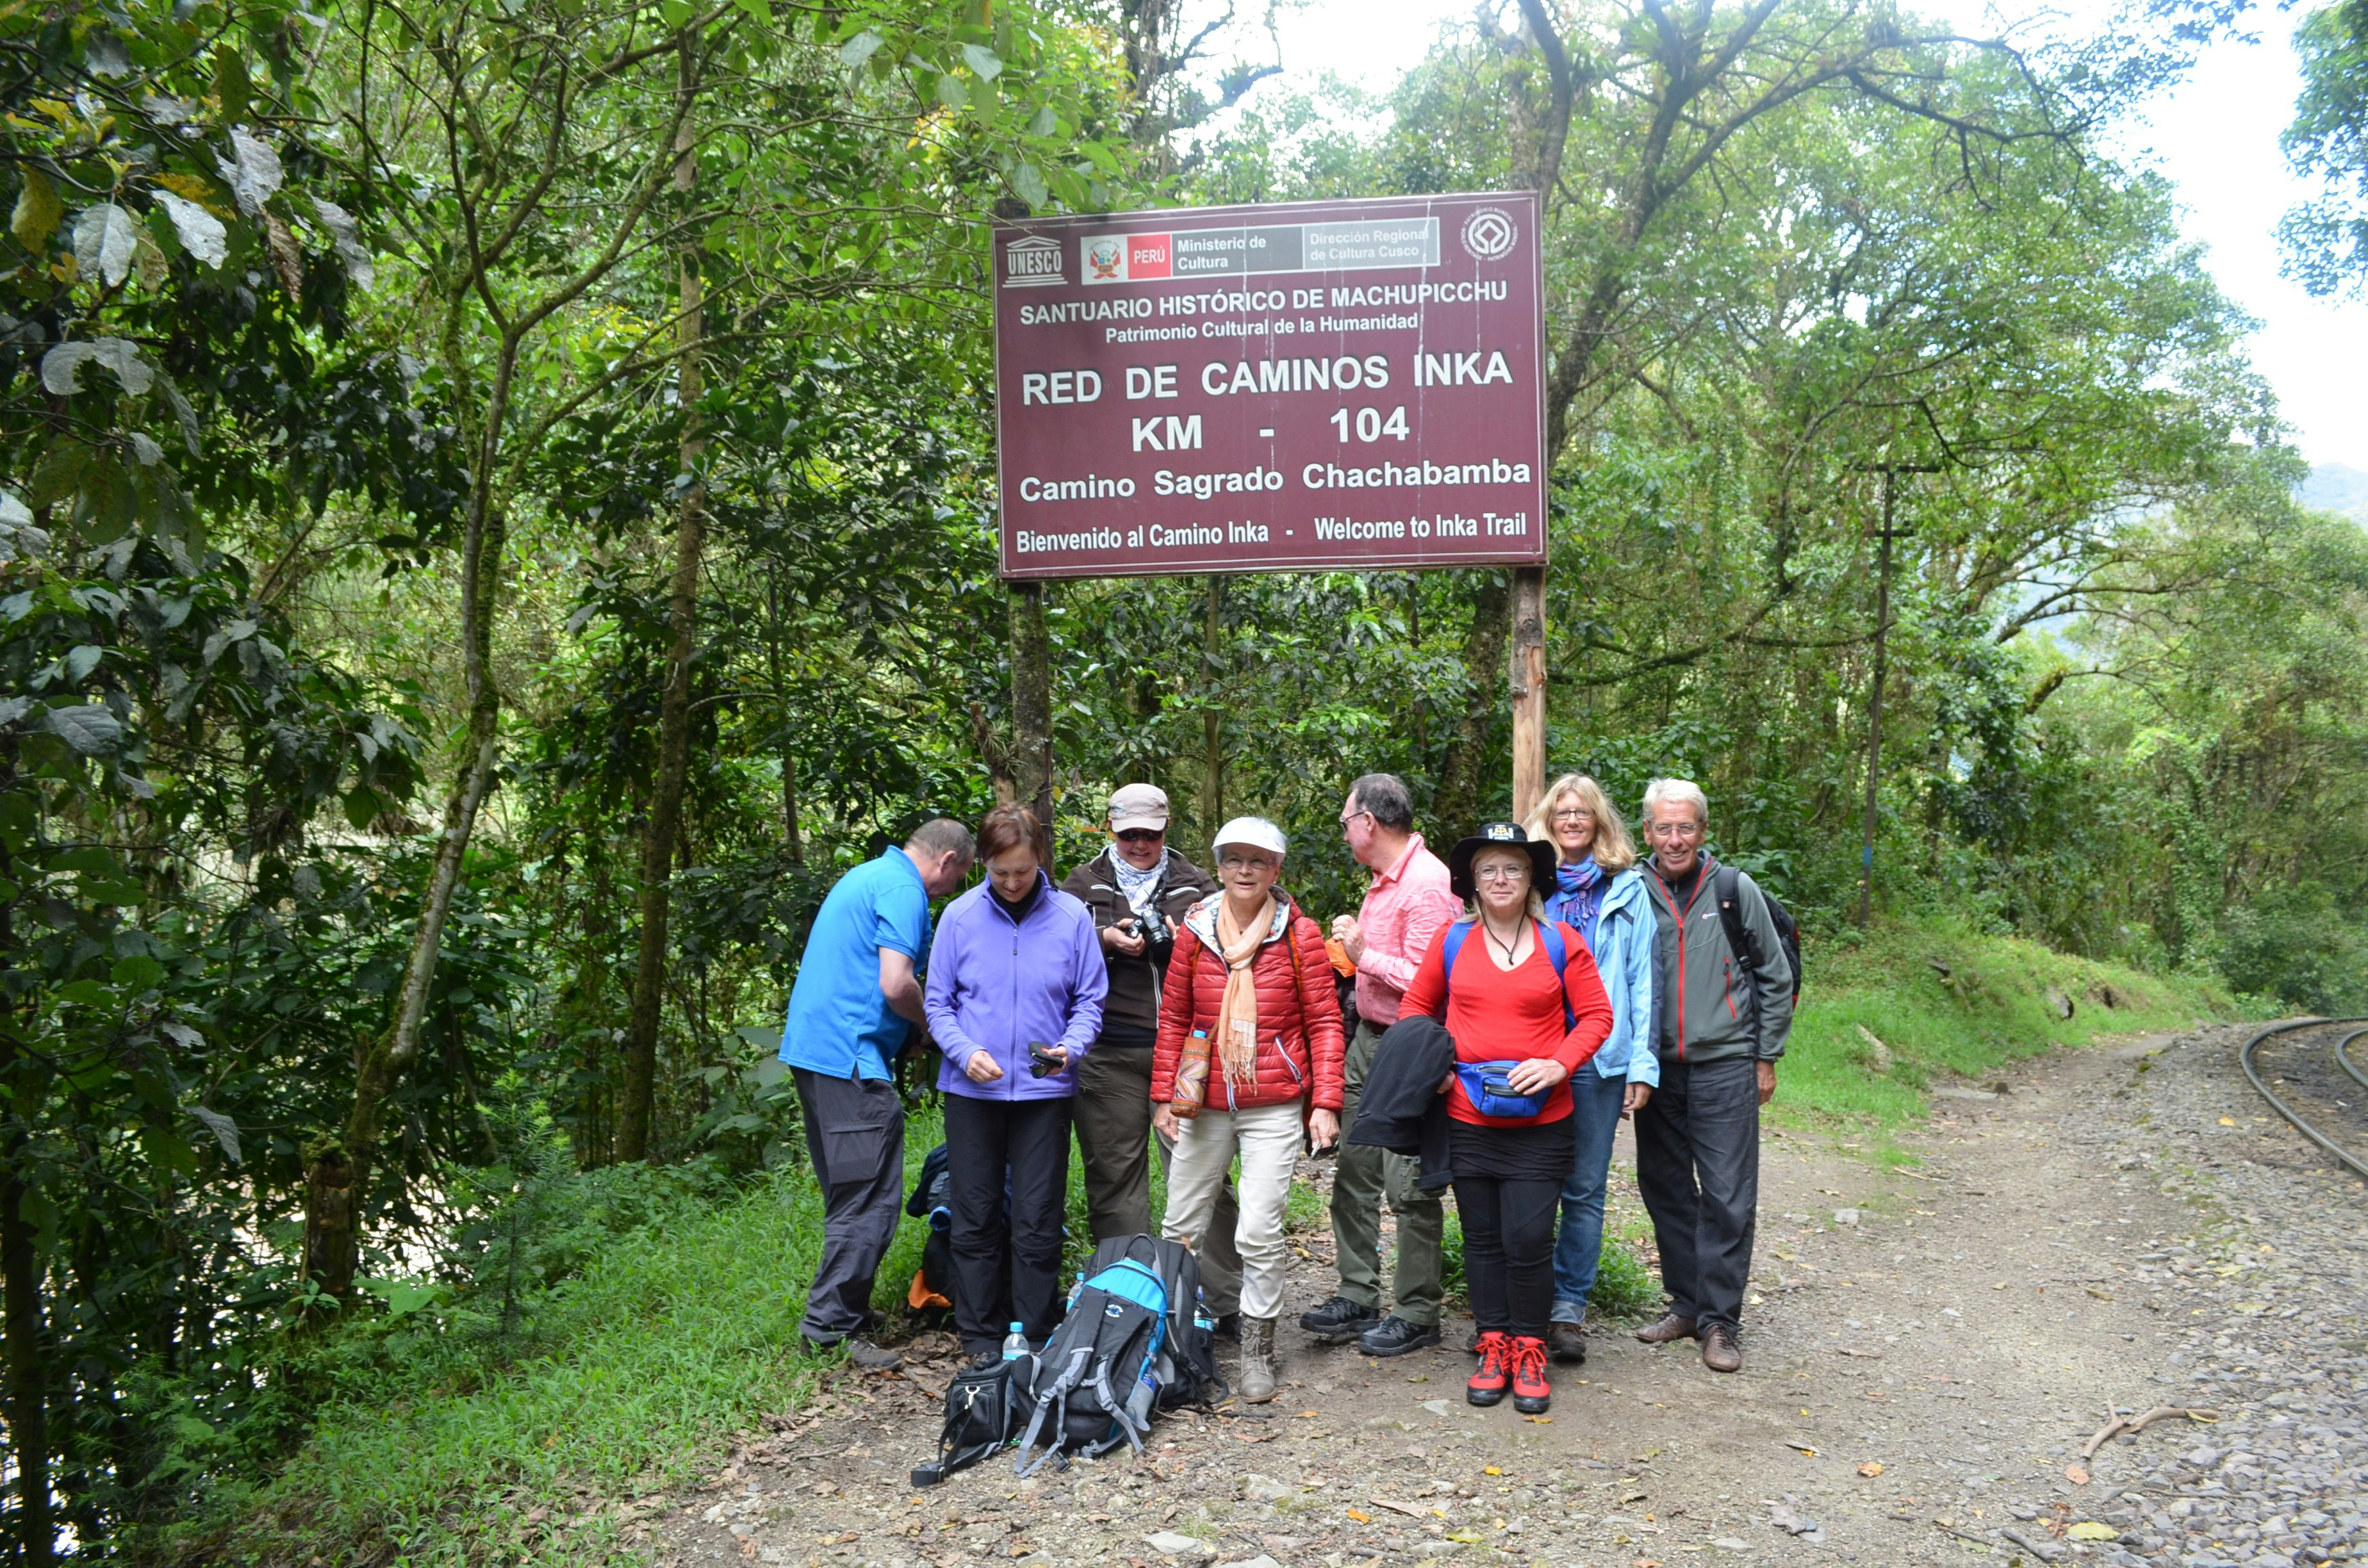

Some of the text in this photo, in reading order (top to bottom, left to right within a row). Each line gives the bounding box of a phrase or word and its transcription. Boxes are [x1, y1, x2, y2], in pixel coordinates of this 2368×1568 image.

[1178, 235, 1267, 253] Ministerio de
[1310, 228, 1429, 245] Dirección Regional
[1008, 250, 1062, 275] UNESCO
[1133, 245, 1165, 264] PERÚ
[1178, 256, 1229, 270] Cultura
[1310, 245, 1420, 262] de Cultura Cusco
[1020, 280, 1507, 325] SANTUARIO HISTÓRICO DE MACHUPICCHU
[1106, 312, 1418, 343] Patrimonio Cultural de la Humanidad
[1023, 351, 1513, 405] RED DE CAMINOS INKA
[1132, 414, 1202, 452] KM
[1330, 406, 1410, 443] 104
[1020, 458, 1531, 502] Camino Sagrado Chachabamba
[1016, 526, 1122, 553] Bienvenido
[1127, 525, 1144, 548] al
[1149, 522, 1223, 546] Camino
[1228, 520, 1269, 543] Inka
[1314, 517, 1405, 540] Welcome
[1410, 516, 1431, 538] to
[1436, 514, 1478, 537] Inka
[1483, 512, 1526, 535] Trail
